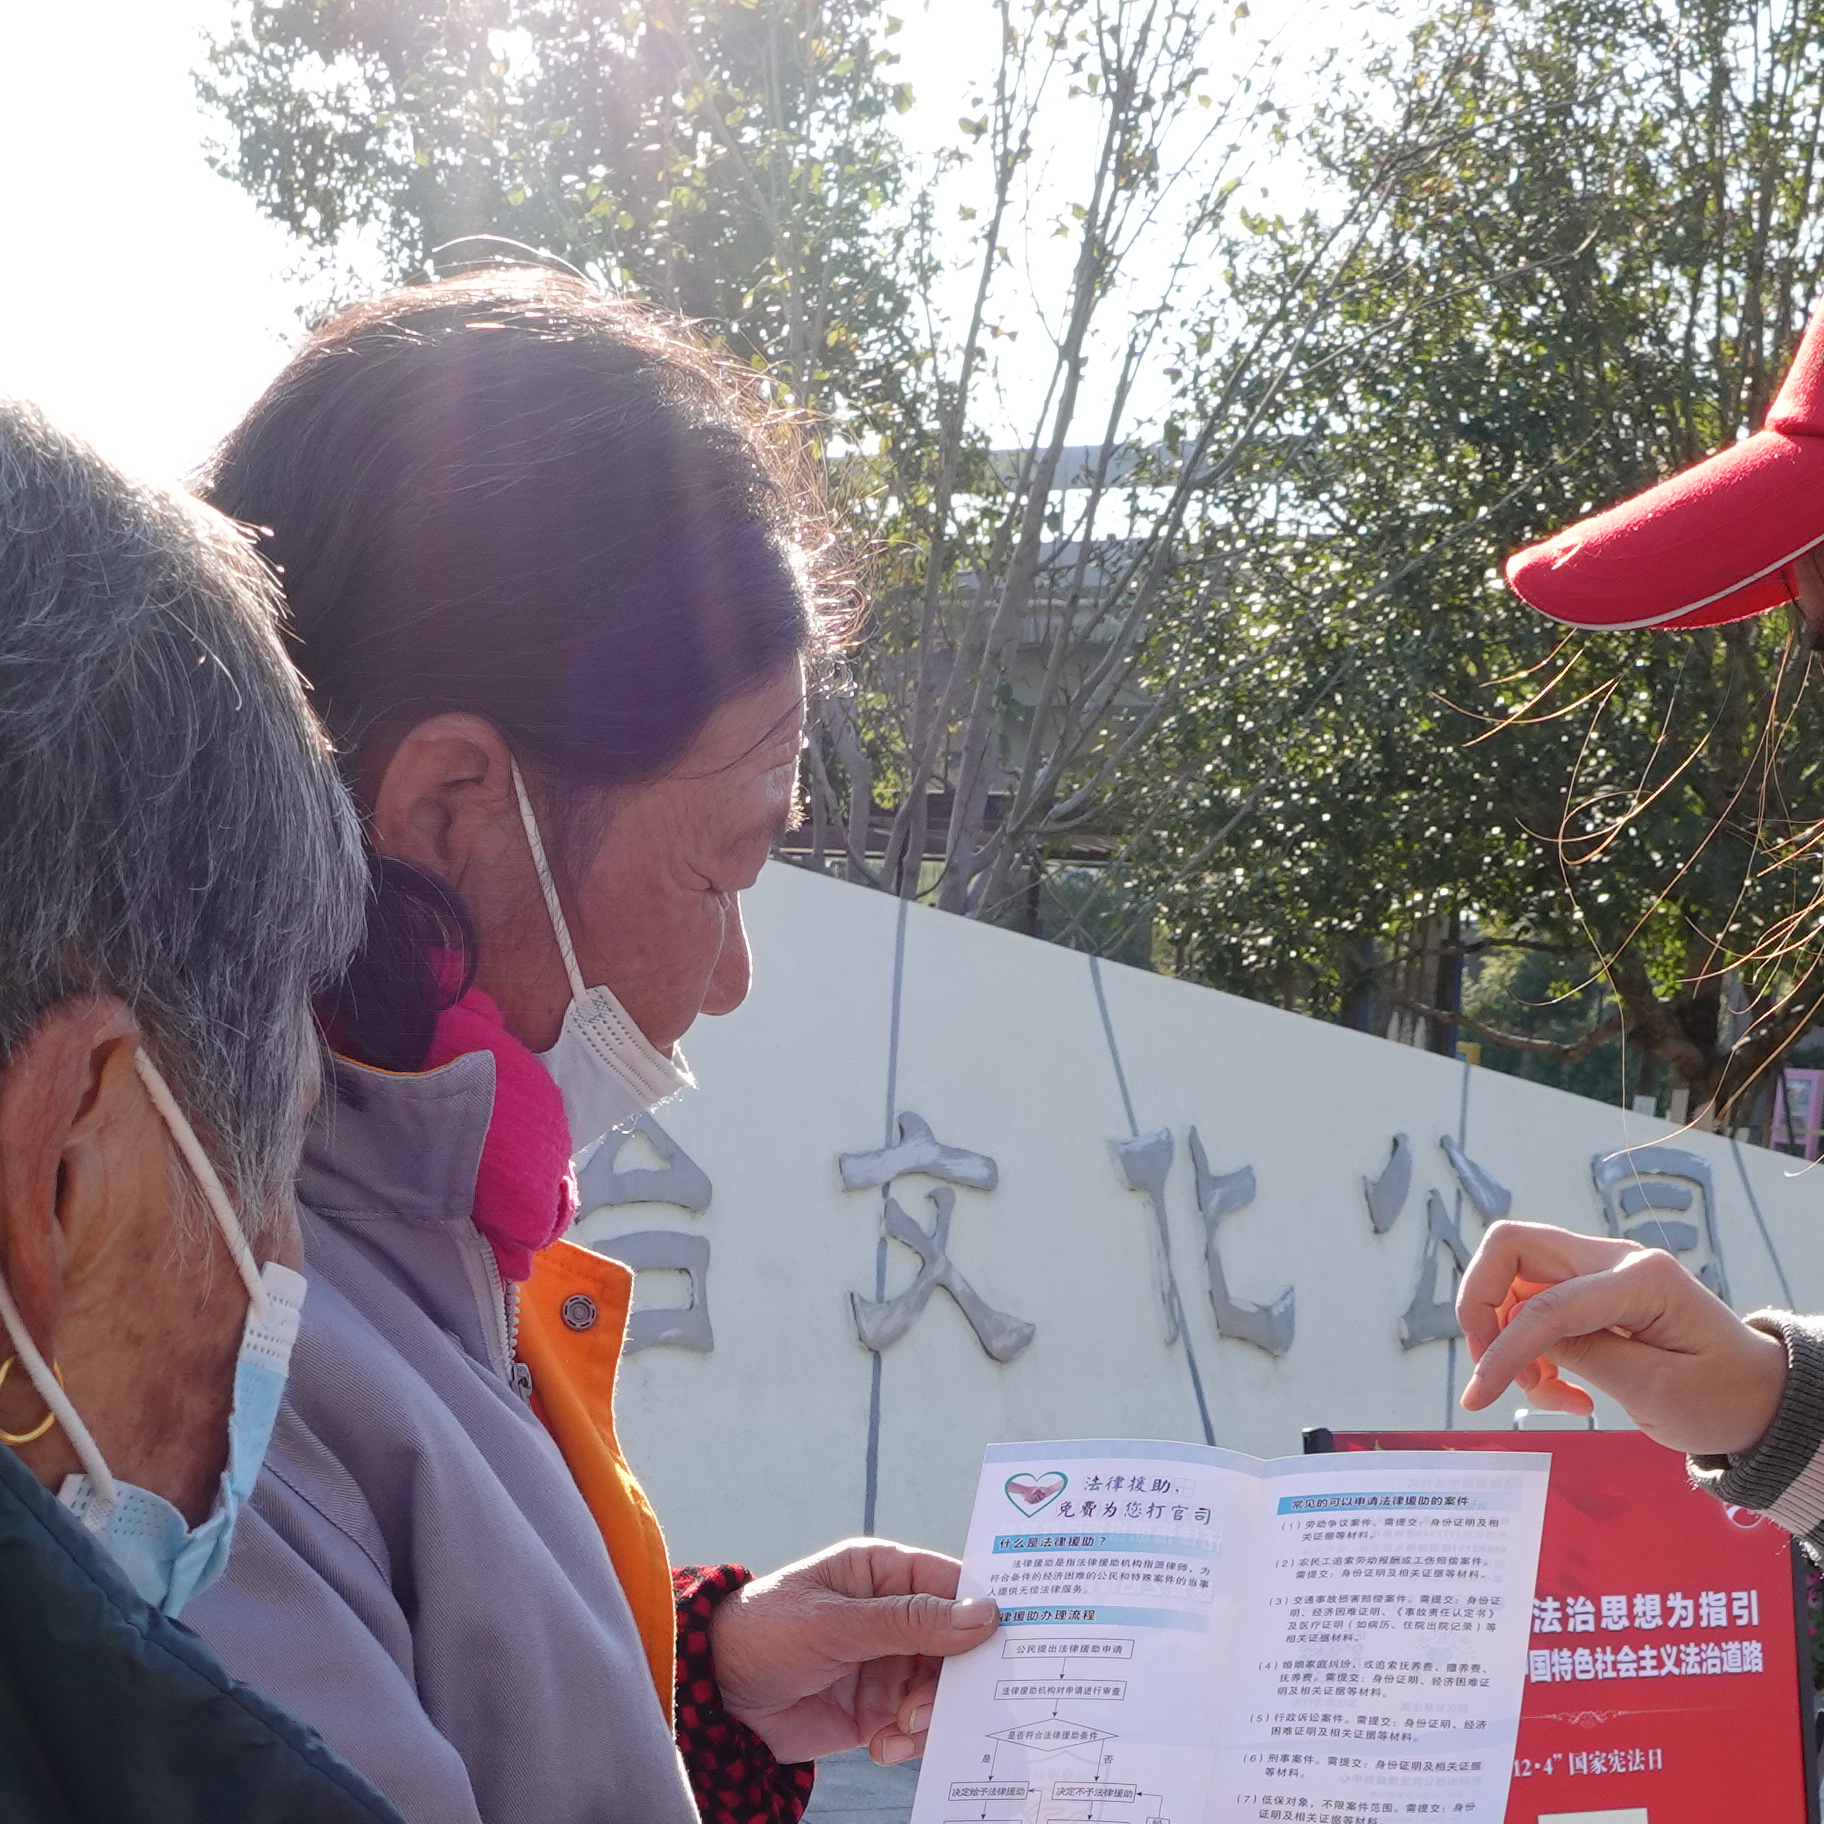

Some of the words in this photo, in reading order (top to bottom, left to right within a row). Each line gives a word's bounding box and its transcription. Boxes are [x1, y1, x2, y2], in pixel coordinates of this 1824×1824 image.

[1056, 1500, 1213, 1525] 免费为您打官司
[999, 1536, 1107, 1550] 什么是法律援助？
[1532, 1590, 1760, 1633] 法治思想为指引
[1016, 1643, 1124, 1655] 公民提出法律援助申请
[1525, 1640, 1764, 1684] 国特色社会主义法治道路
[1002, 1685, 1122, 1697] 法律援助机构对申请进行审查
[1007, 1730, 1099, 1741] 是否符合法律援助条件
[981, 1754, 992, 1764] 是
[1103, 1754, 1114, 1764] 否
